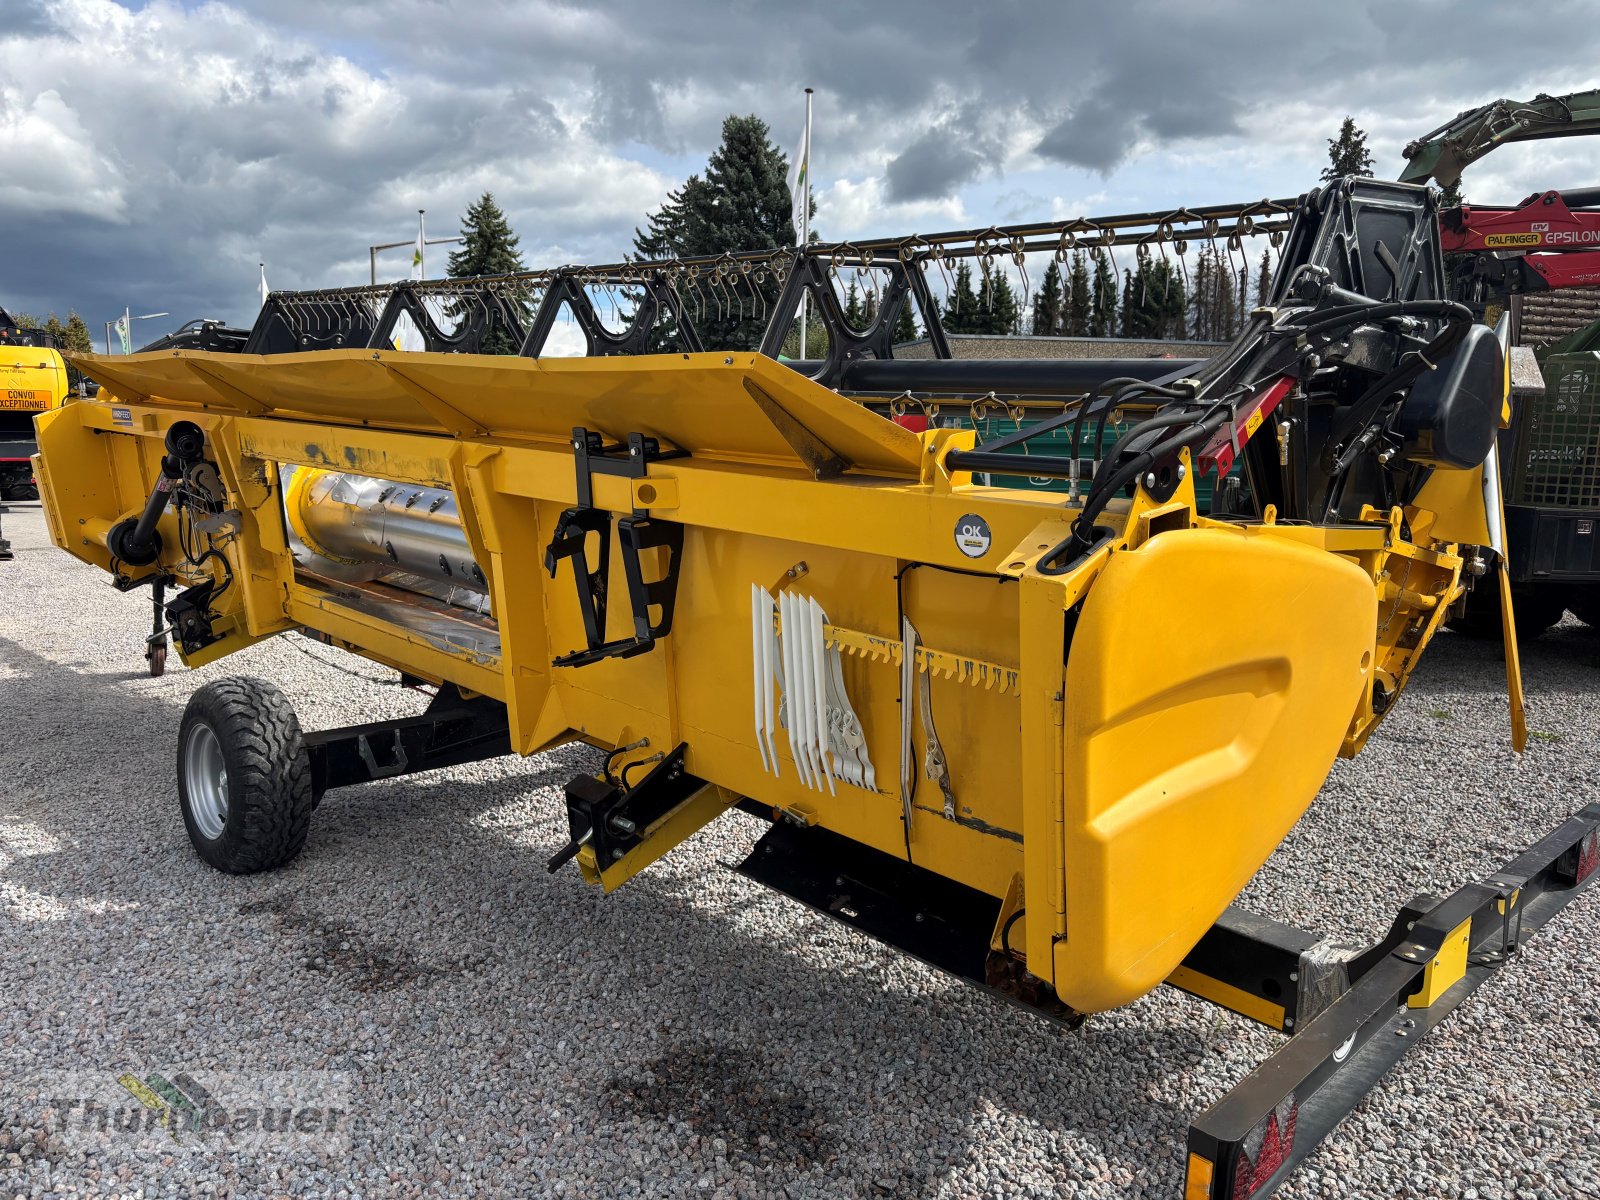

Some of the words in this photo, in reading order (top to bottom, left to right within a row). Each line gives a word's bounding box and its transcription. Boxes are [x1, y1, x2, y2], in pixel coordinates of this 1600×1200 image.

[1487, 234, 1538, 245] PALFINGER
[1545, 230, 1600, 244] EPSILON
[8, 390, 35, 399] CONVOI
[962, 524, 982, 538] OK
